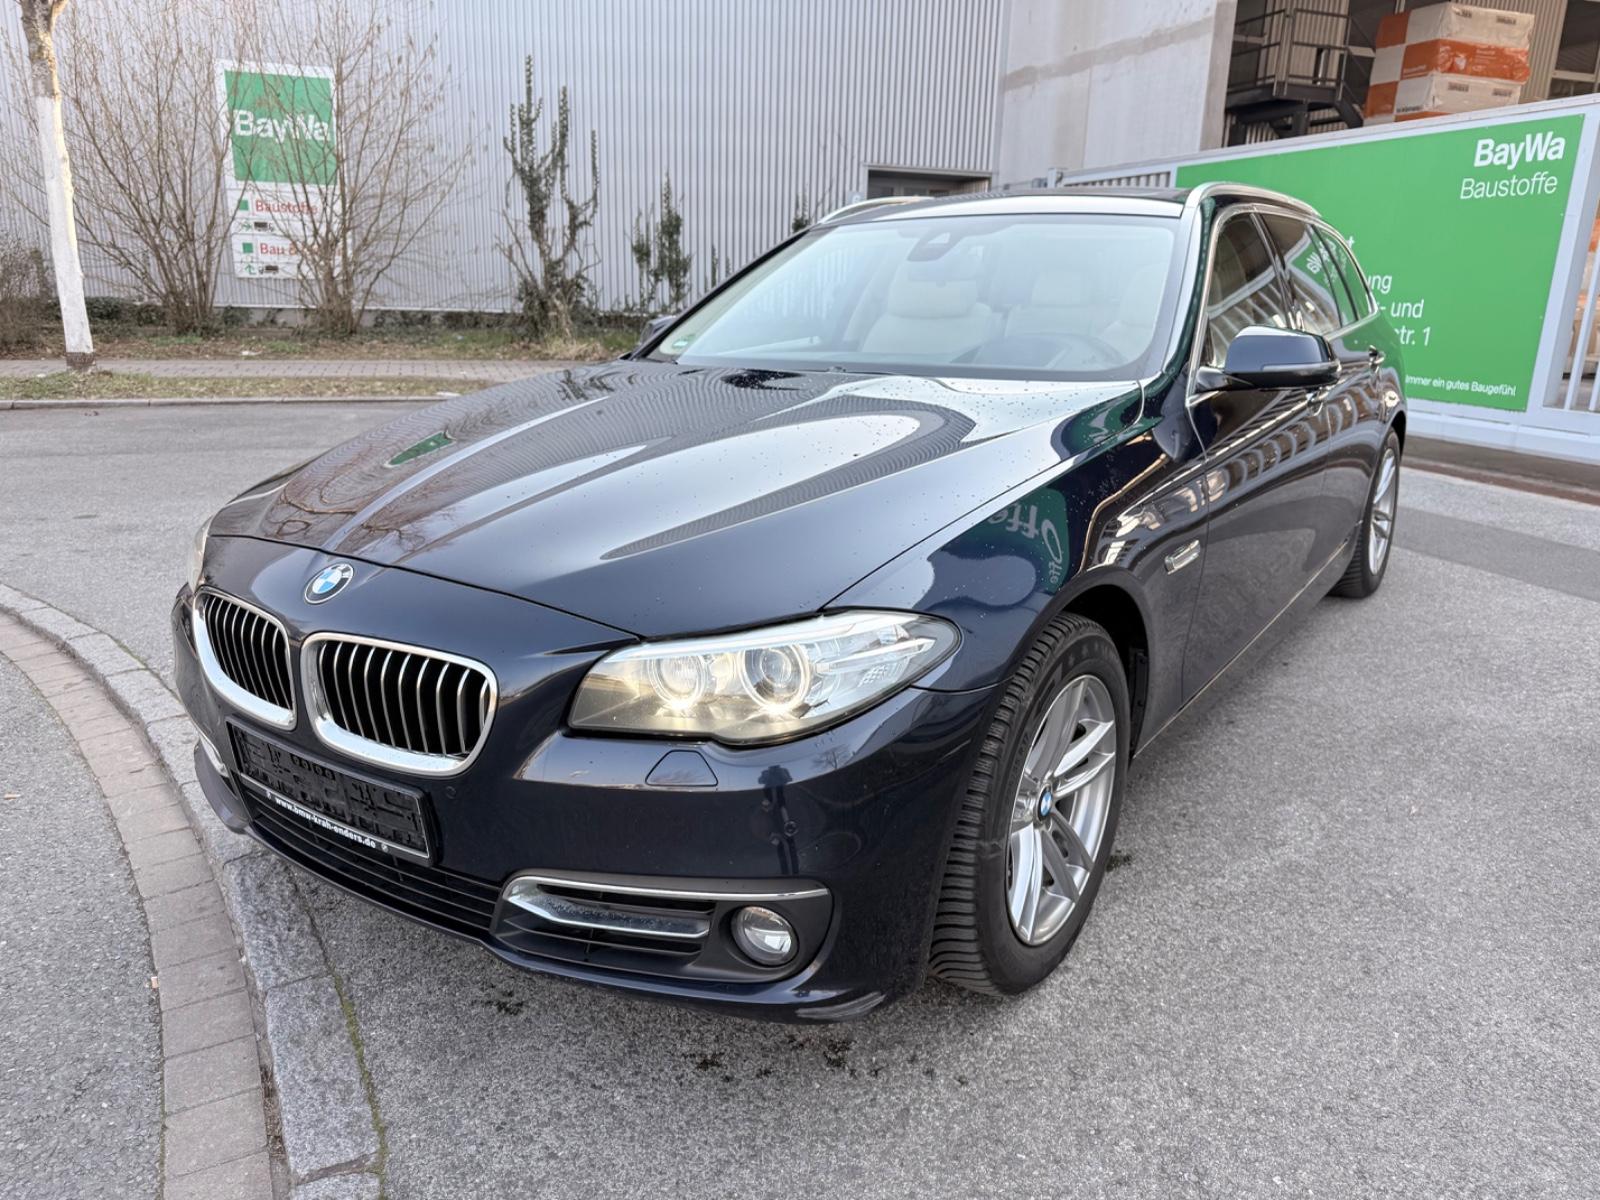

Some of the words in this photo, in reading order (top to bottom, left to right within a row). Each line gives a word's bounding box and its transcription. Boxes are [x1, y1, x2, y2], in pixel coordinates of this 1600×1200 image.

[233, 109, 330, 144] BayWa
[1474, 131, 1565, 170] BayWa
[1460, 171, 1558, 199] Baustoffe
[1391, 299, 1424, 318] und
[1423, 327, 1431, 346] 1
[1405, 374, 1432, 386] Immer
[1432, 378, 1445, 388] ein
[1446, 380, 1469, 391] gutes
